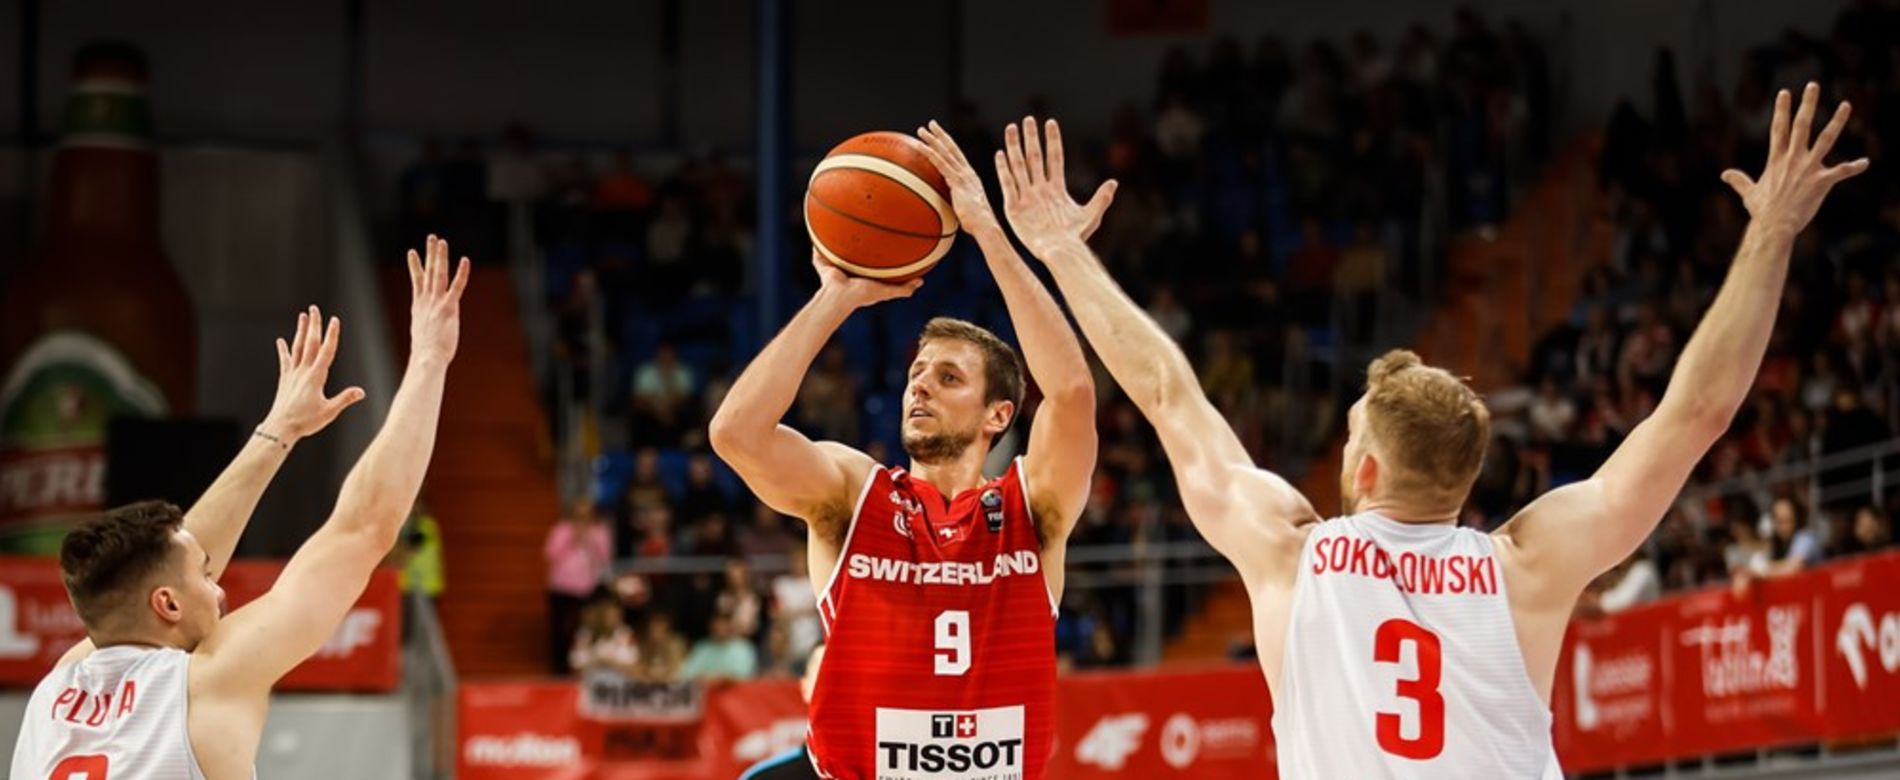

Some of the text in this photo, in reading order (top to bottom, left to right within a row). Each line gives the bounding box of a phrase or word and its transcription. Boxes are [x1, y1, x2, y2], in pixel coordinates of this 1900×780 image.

[849, 551, 1040, 585] SWITZERLAND
[934, 610, 972, 676] 9
[51, 681, 135, 727] PLUA
[1374, 619, 1445, 761] 3
[879, 739, 1021, 772] TISSOT
